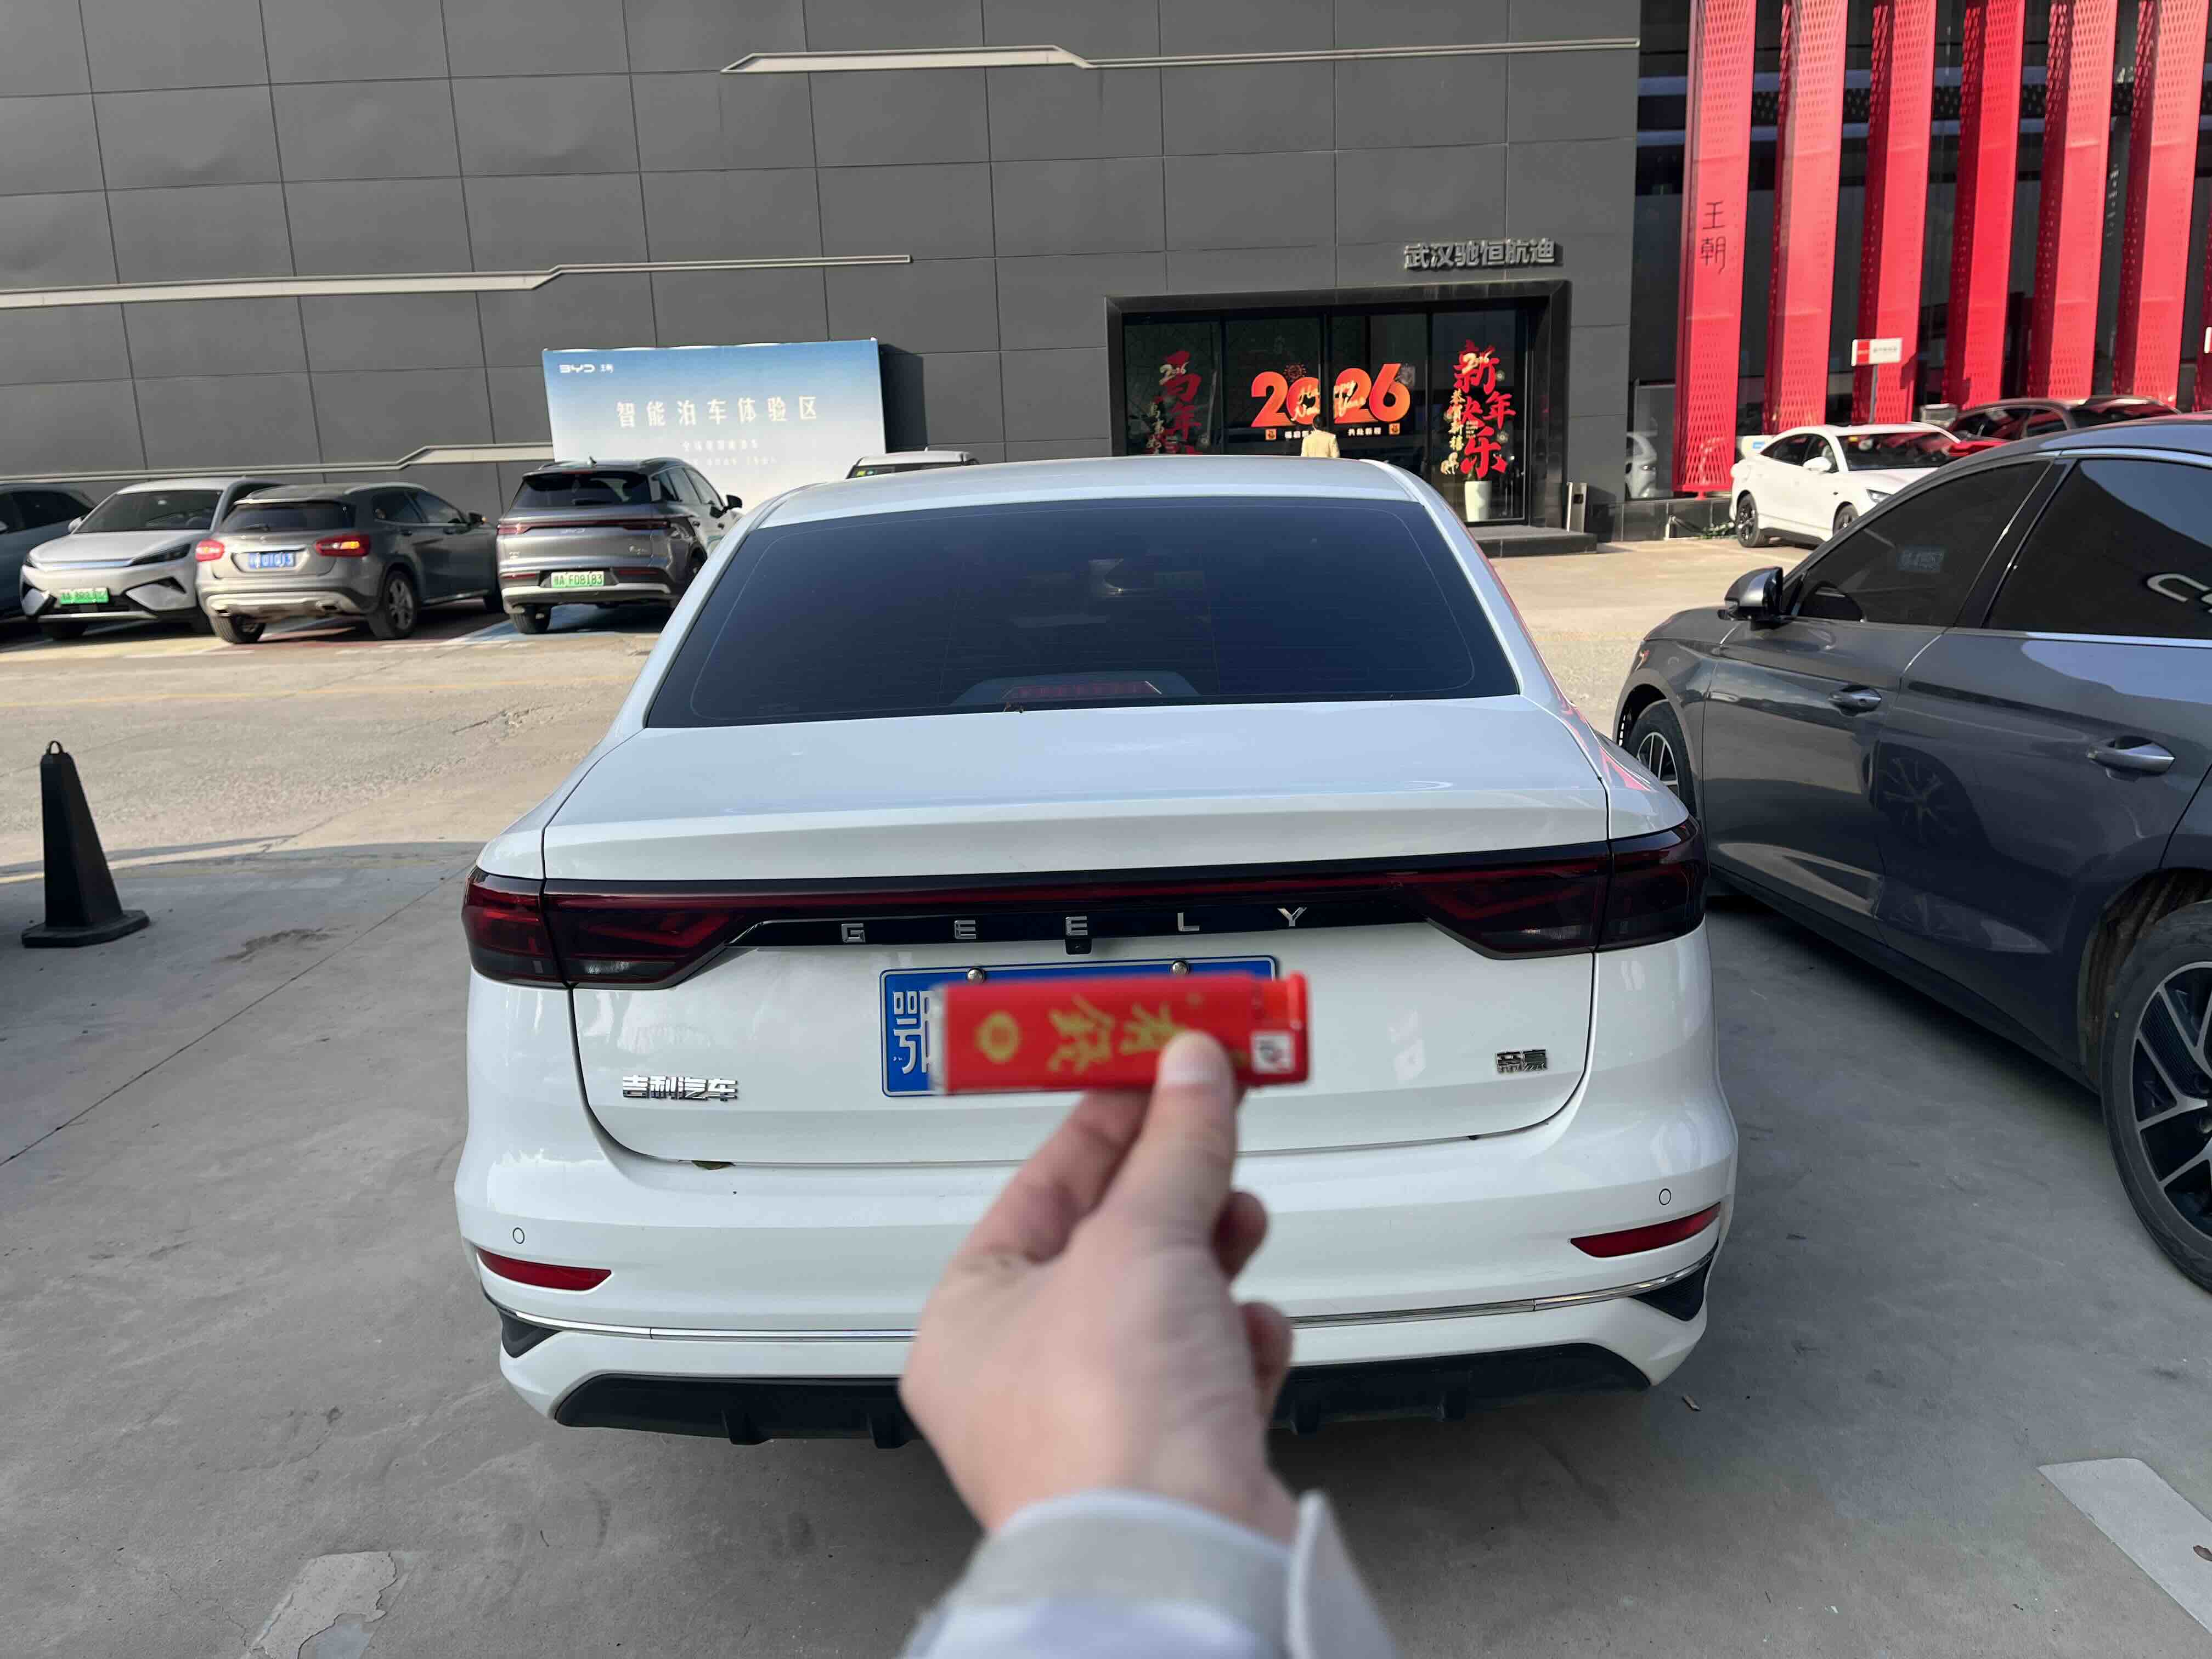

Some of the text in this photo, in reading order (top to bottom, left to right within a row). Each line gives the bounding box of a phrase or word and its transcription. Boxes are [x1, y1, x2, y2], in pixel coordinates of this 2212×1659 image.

[1404, 238, 1555, 269] 武汉驰恒航迪
[559, 364, 595, 374] BYD
[1251, 363, 1410, 427] 2026
[617, 396, 817, 428] 智能泊车体验区
[842, 907, 1307, 944] GEELY
[623, 1075, 738, 1102] 吉利汽车
